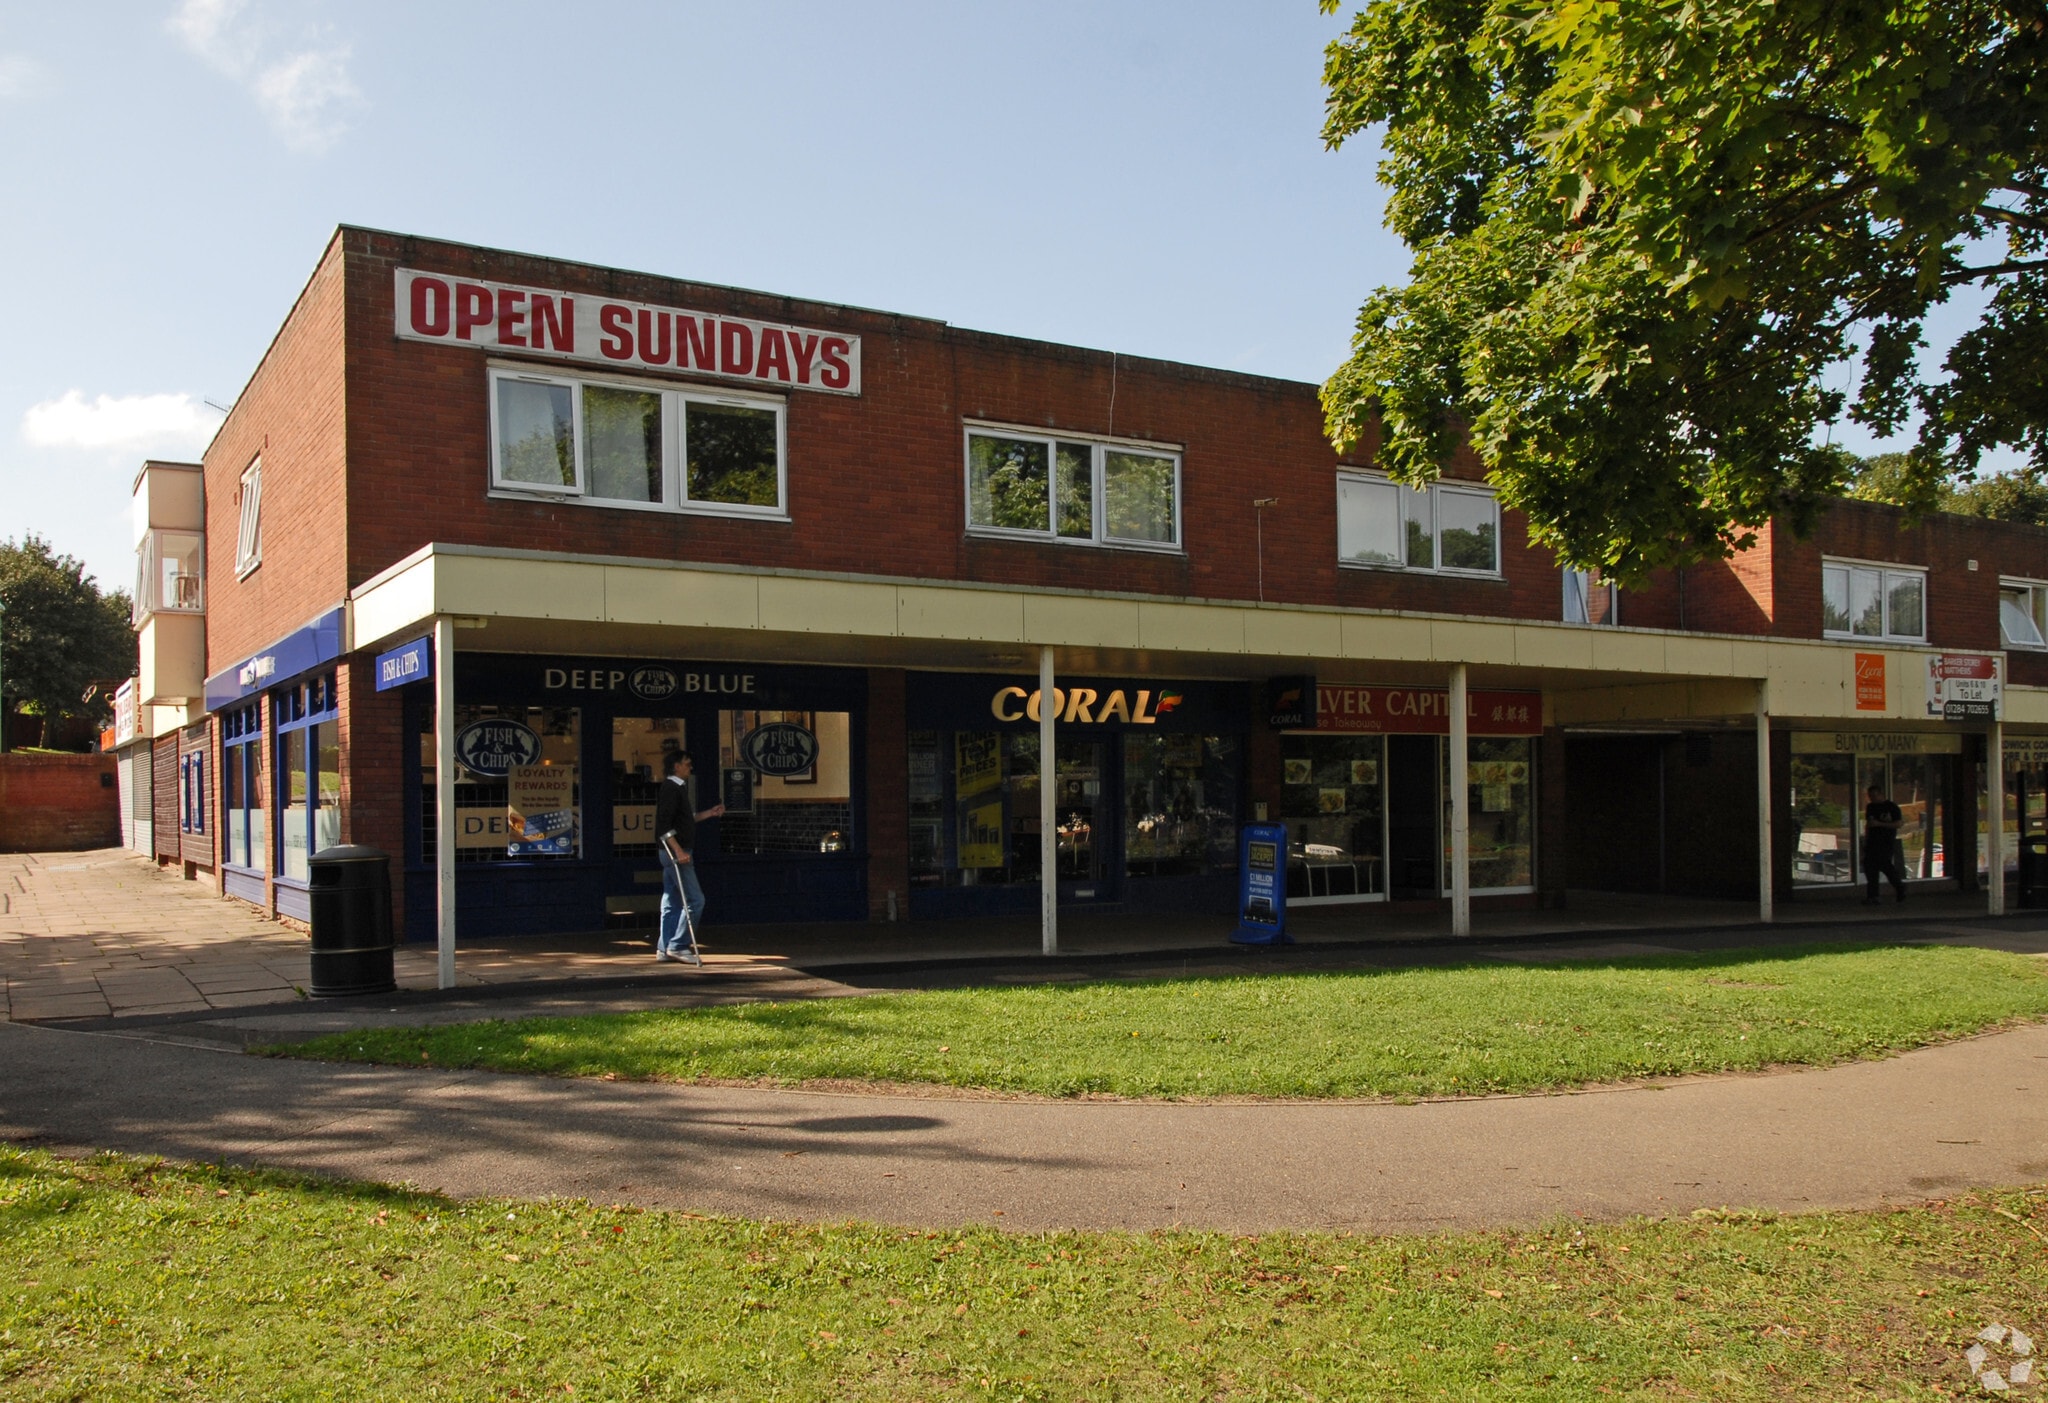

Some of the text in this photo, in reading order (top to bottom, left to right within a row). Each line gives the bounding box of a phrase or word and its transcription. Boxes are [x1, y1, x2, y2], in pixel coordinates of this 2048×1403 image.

[410, 276, 850, 389] OPEN SUNDAYS
[383, 658, 396, 682] FISH
[401, 649, 419, 676] CHIPS
[1943, 657, 1963, 666] BARKER
[545, 668, 755, 694] DEEP BLUE
[646, 669, 665, 681] FISH
[644, 683, 666, 694] CHIPS
[1956, 680, 1969, 688] Units
[1960, 689, 1982, 699] To Let
[991, 686, 1157, 724] CORAL
[1316, 689, 1477, 717] LVER CAPITL
[1946, 704, 1965, 713] 01284
[1271, 714, 1302, 725] CORAL
[1334, 717, 1382, 730] Takeaway
[484, 727, 514, 746] FISH
[770, 730, 795, 747] FISH
[1836, 734, 1918, 751] BUN TOO MANY
[494, 743, 504, 754] &
[778, 744, 787, 754] &
[480, 751, 517, 768] CHIPS
[767, 752, 799, 769] CHIPS
[517, 769, 565, 778] LOYALTY
[960, 757, 996, 778] PRICES
[515, 781, 568, 791] REWARDS
[1251, 853, 1273, 862] JACKPOT
[1256, 873, 1273, 882] MILLION
